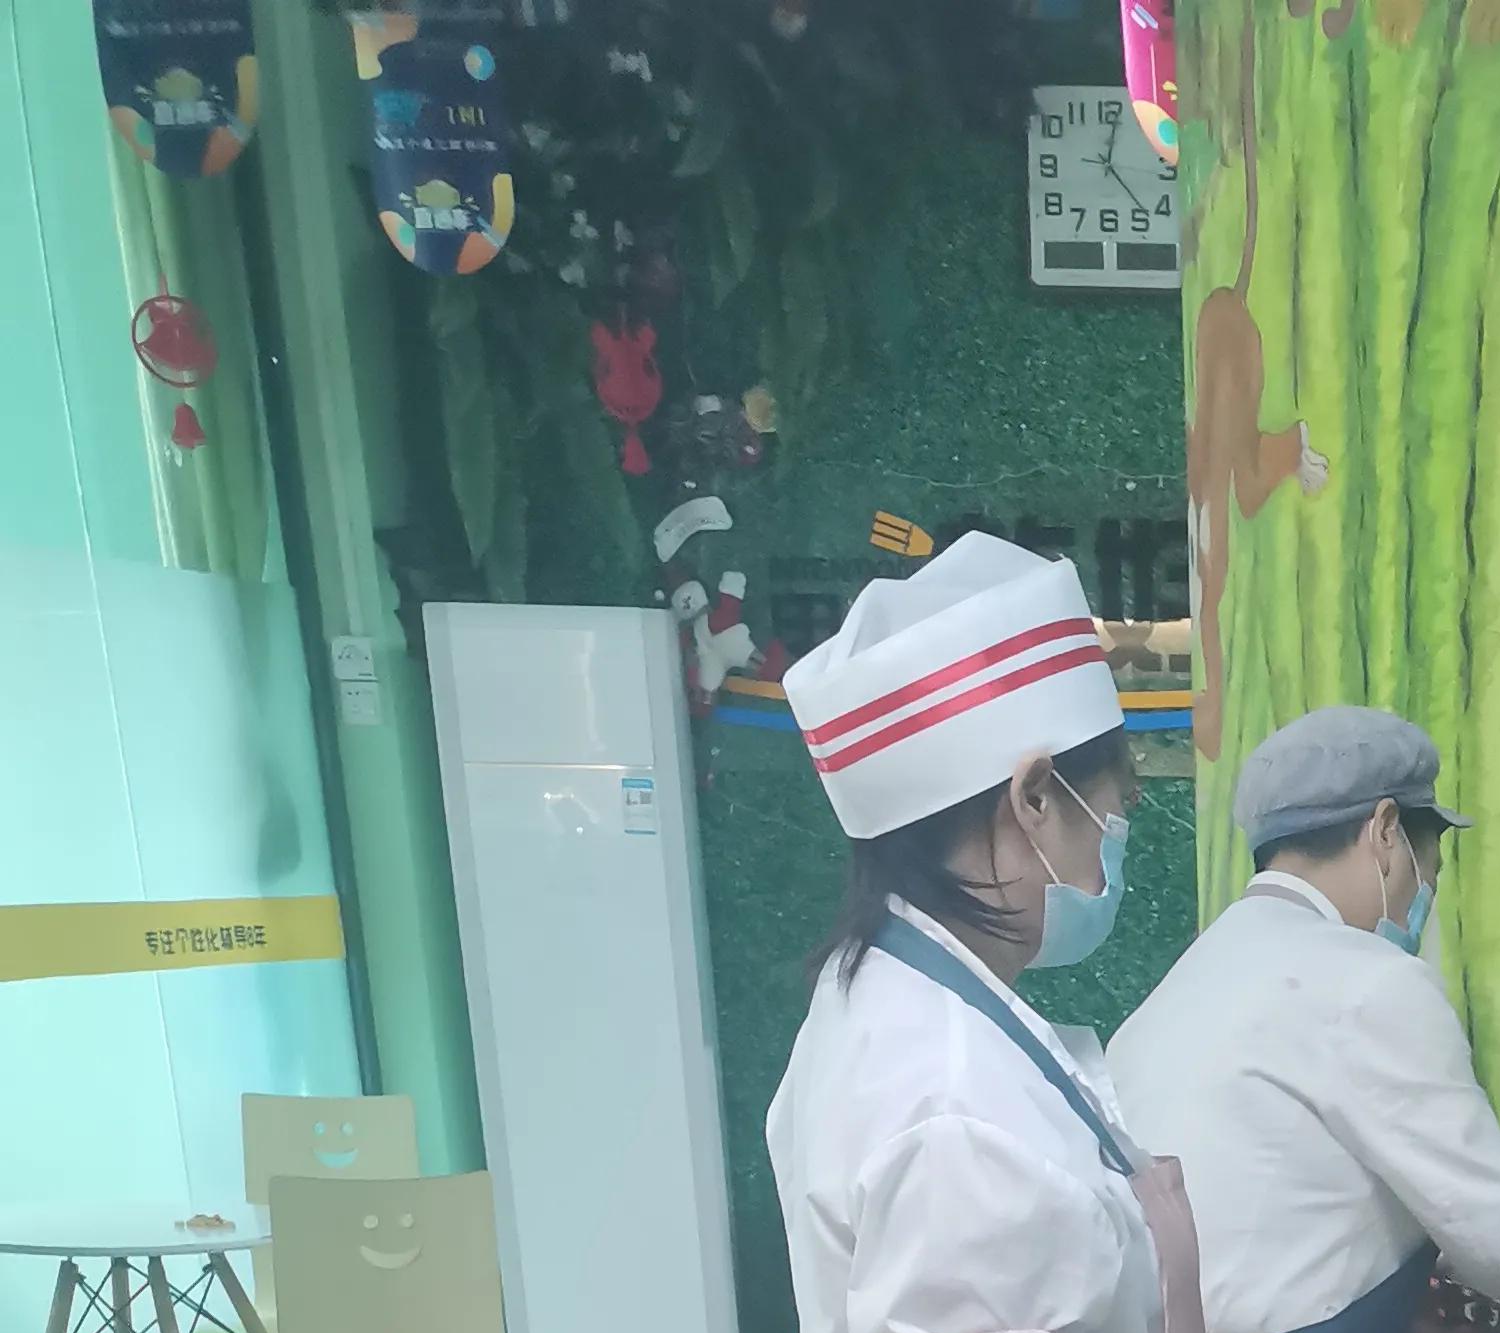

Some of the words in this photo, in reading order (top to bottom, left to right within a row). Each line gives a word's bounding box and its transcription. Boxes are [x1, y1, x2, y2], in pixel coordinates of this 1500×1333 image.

[1068, 101, 1085, 124] 11
[1098, 101, 1123, 124] 12
[1041, 114, 1063, 138] 10
[1040, 154, 1057, 178] 9
[1045, 192, 1062, 215] 8
[1154, 194, 1171, 216] 4
[1070, 208, 1086, 232] 7
[1100, 209, 1118, 232] 6
[1131, 208, 1149, 232] 5
